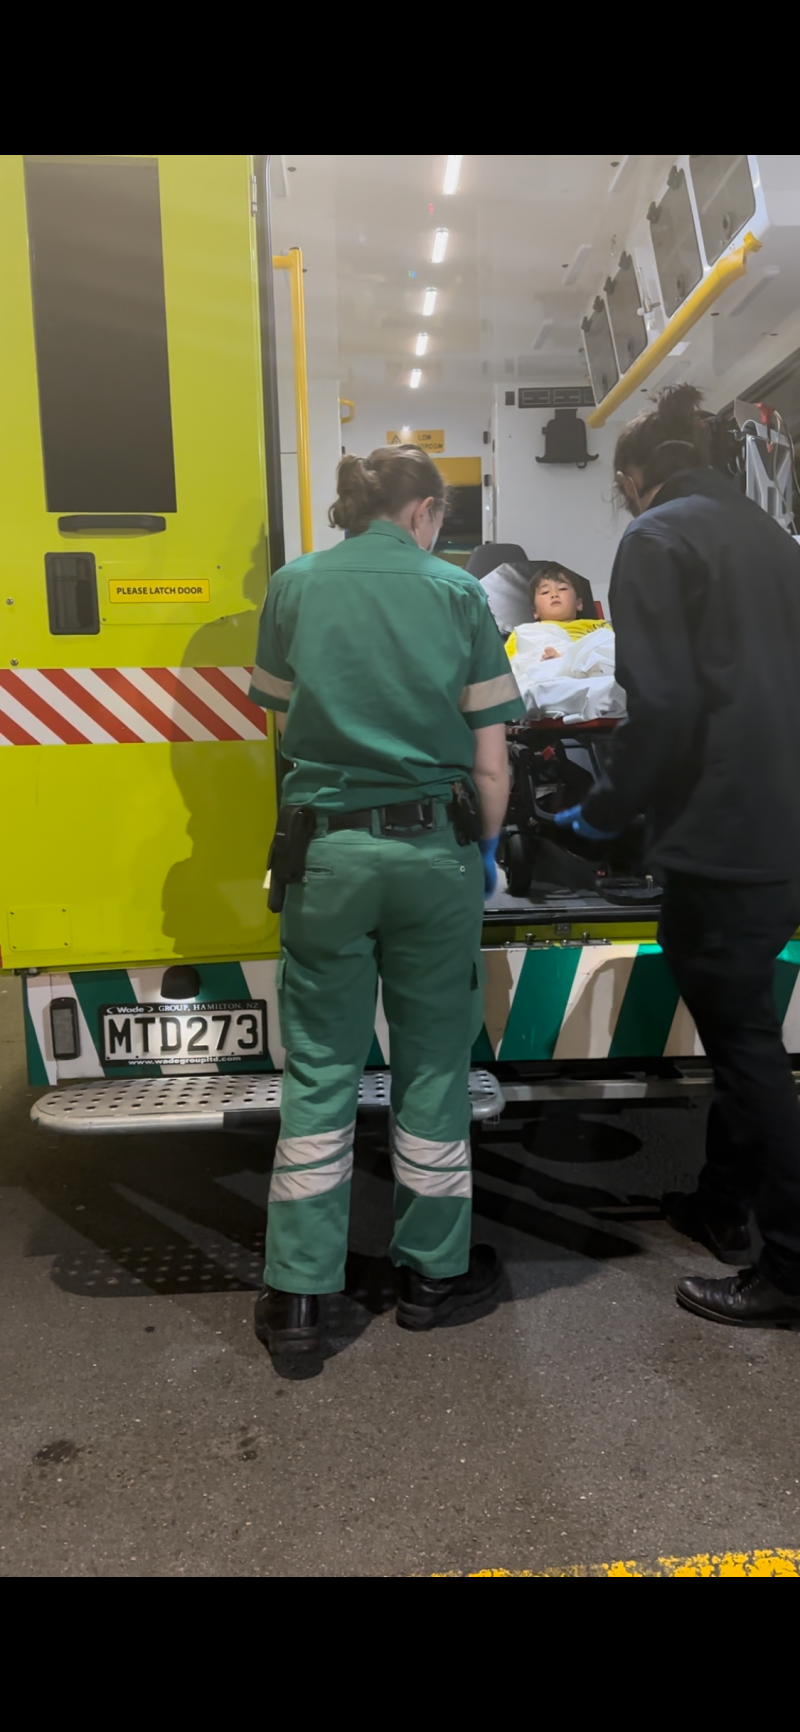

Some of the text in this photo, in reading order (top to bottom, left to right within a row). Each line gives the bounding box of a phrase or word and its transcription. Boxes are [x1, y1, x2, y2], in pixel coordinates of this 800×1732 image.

[116, 586, 203, 595] PLEASE LATCH DOOR
[158, 1004, 191, 1012] GROUP,
[108, 1014, 259, 1054] MTD273
[128, 1056, 241, 1065] www.wadegroupltd.com
